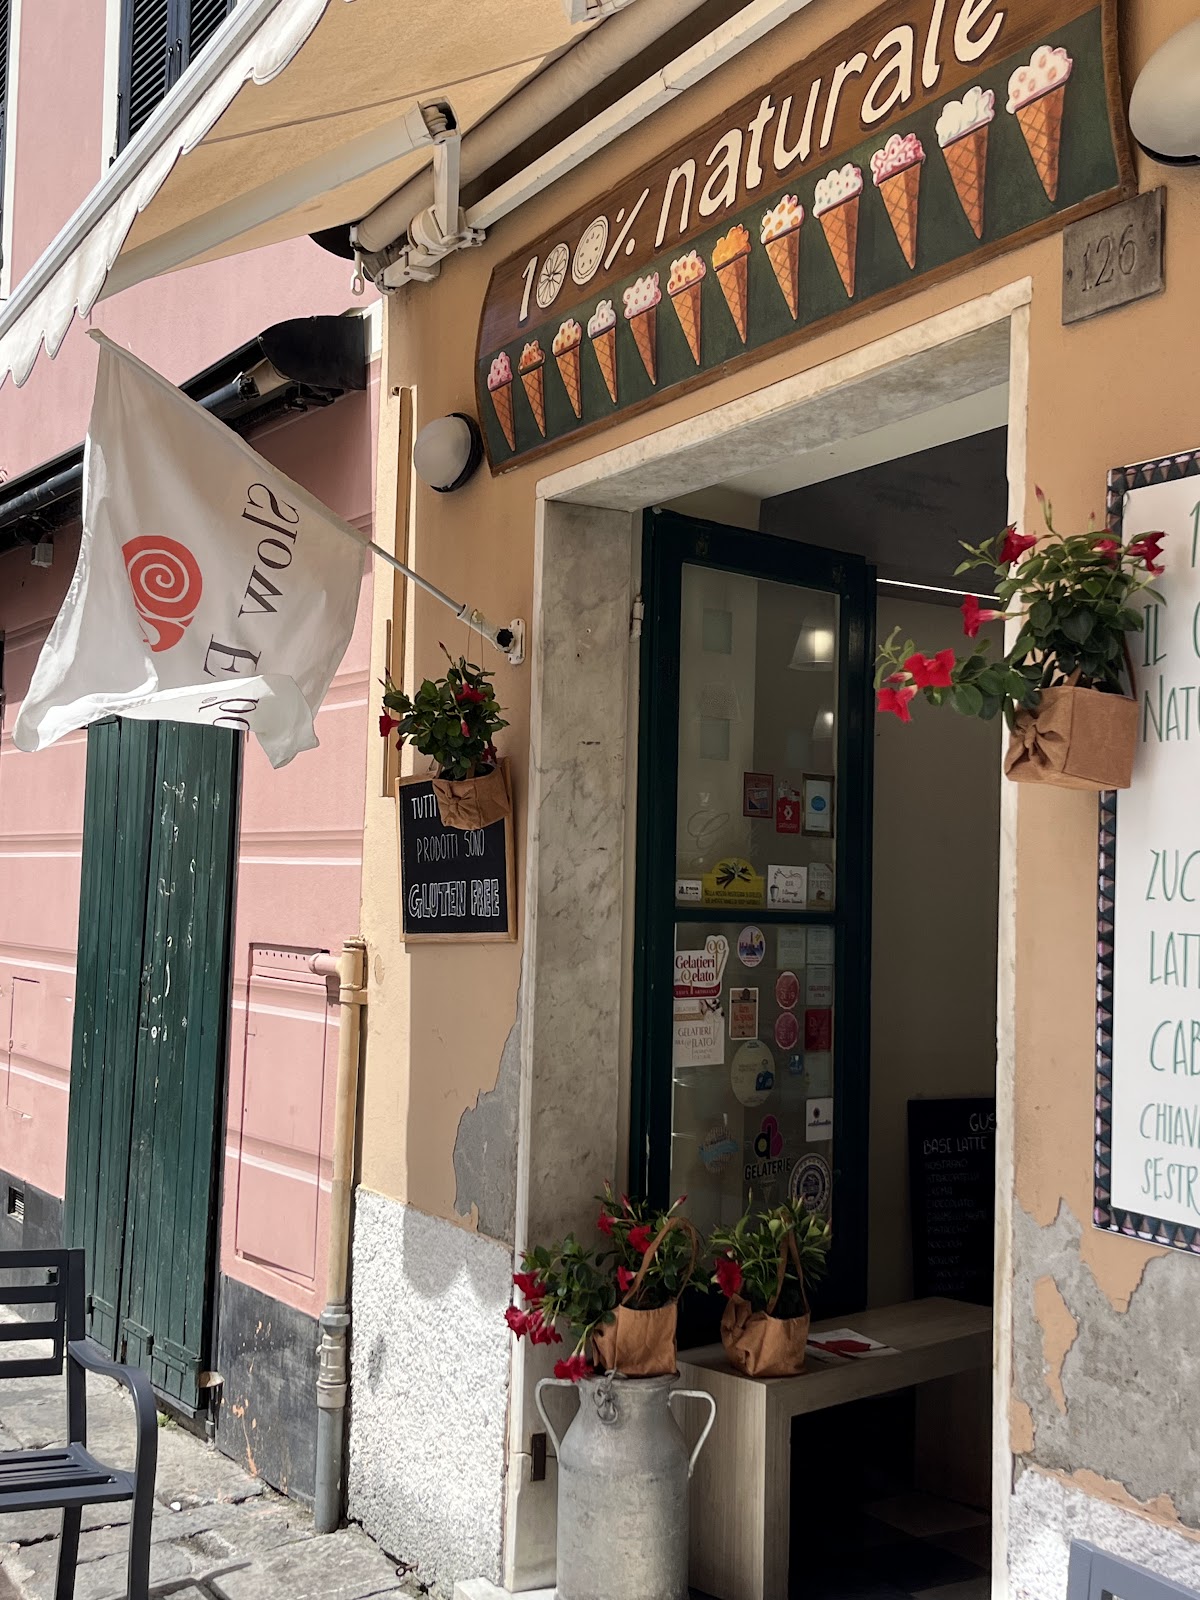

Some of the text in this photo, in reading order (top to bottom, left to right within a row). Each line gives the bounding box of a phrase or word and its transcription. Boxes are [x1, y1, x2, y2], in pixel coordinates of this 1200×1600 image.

[519, 0, 1004, 322] 100% naturale
[1081, 223, 1137, 292] 126
[1141, 603, 1167, 668] IL
[416, 828, 485, 863] PRODOTTI SONO
[408, 878, 500, 919] GLUTEN FREE
[675, 955, 715, 970] Gelatieri
[923, 1136, 987, 1156] BASE LATTE
[744, 1157, 791, 1181] GELATERIE
